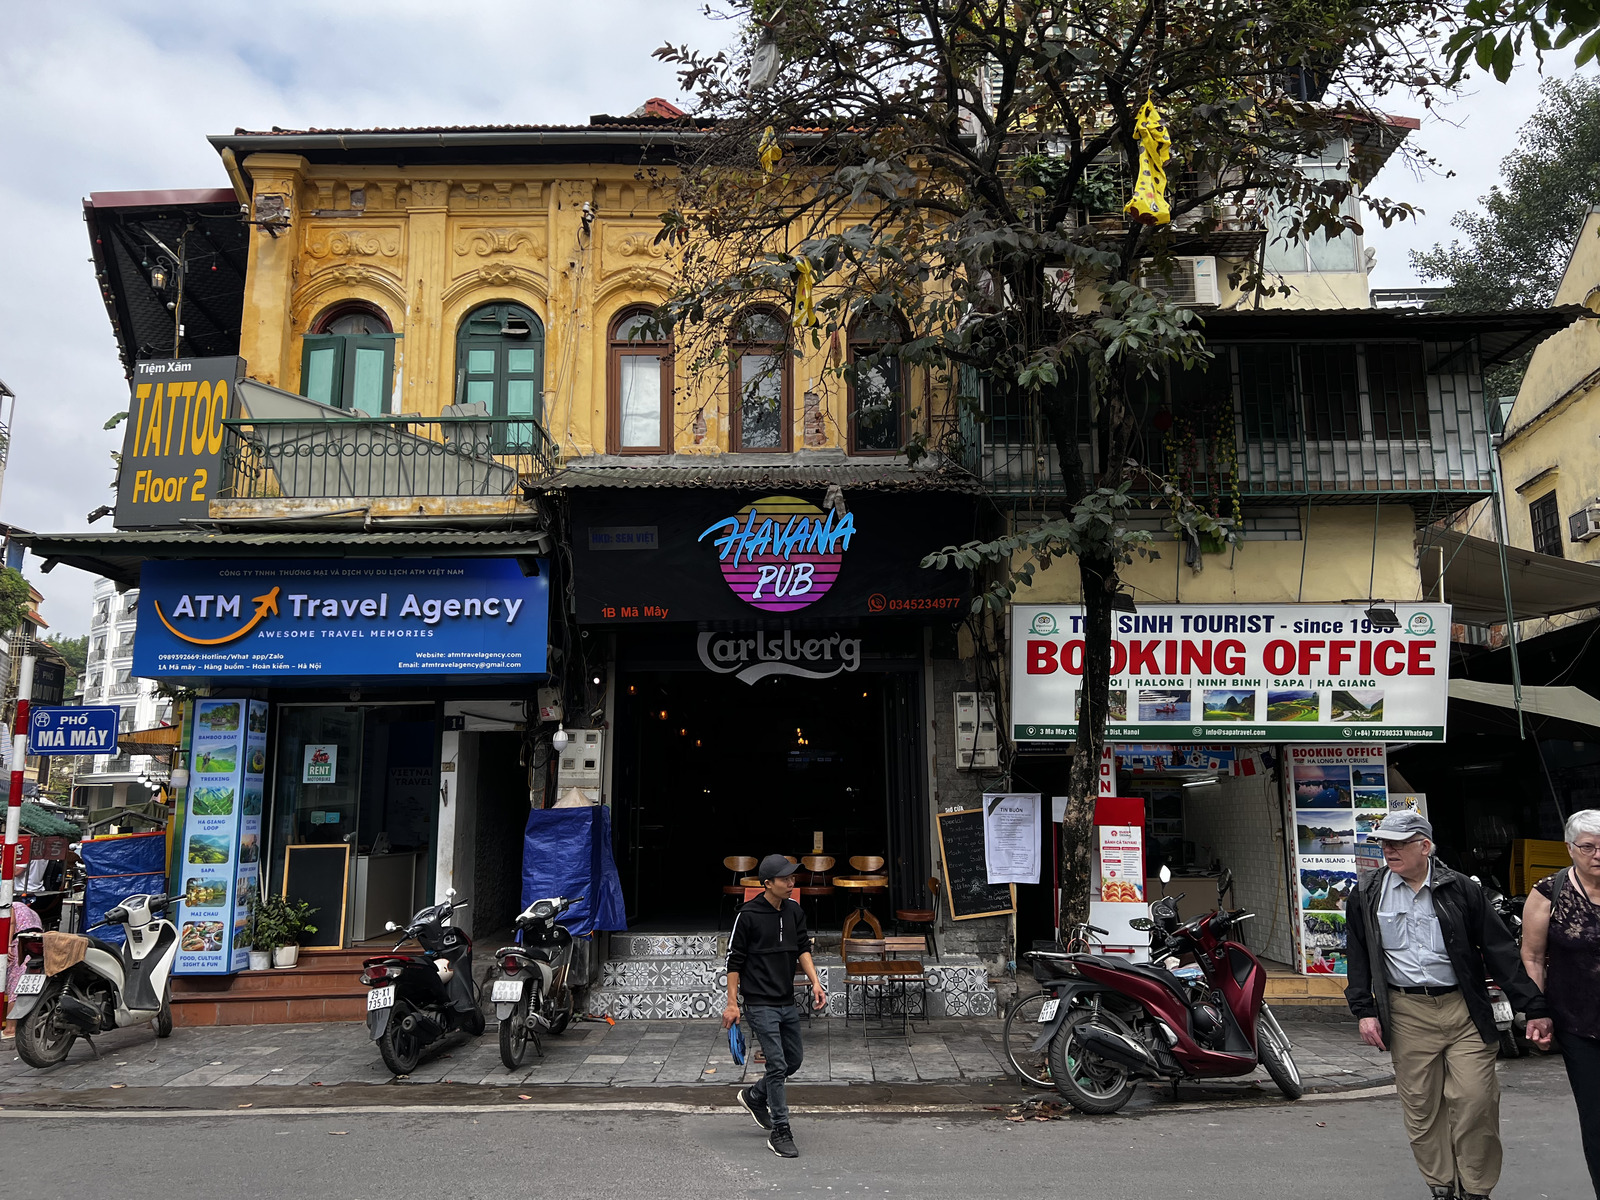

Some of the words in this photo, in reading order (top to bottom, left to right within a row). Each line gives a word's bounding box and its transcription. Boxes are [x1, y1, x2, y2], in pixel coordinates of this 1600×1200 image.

[138, 363, 165, 376] Tiệm
[166, 362, 192, 372] Xăm
[133, 379, 228, 457] TATTOO
[132, 470, 188, 503] Floor
[190, 468, 208, 502] 2
[616, 532, 634, 543] SEN
[698, 507, 856, 568] HAVANA
[752, 562, 815, 600] PUB
[172, 594, 240, 618] ATM
[288, 593, 388, 617] Travel
[399, 593, 523, 624] Agency
[889, 598, 960, 610] 0345234977
[602, 607, 616, 618] 1B
[621, 606, 639, 618] Mã
[644, 606, 669, 619] Mây
[1118, 615, 1173, 634] SINH
[1181, 615, 1274, 634] TOURIST
[1293, 619, 1348, 634] since
[252, 654, 284, 662] app/Zalo
[697, 630, 862, 674] Carlsberg
[1262, 639, 1436, 676] OFFICE
[60, 712, 88, 725] PHỐ
[38, 727, 65, 746] MÃ
[70, 726, 108, 746] MÂY
[1292, 748, 1342, 757] BOOKING
[1346, 747, 1383, 756] OFFICE
[309, 766, 329, 775] RENT
[1390, 800, 1404, 808] iger
[371, 988, 390, 1000] 29-X1
[369, 997, 391, 1009] 735.01
